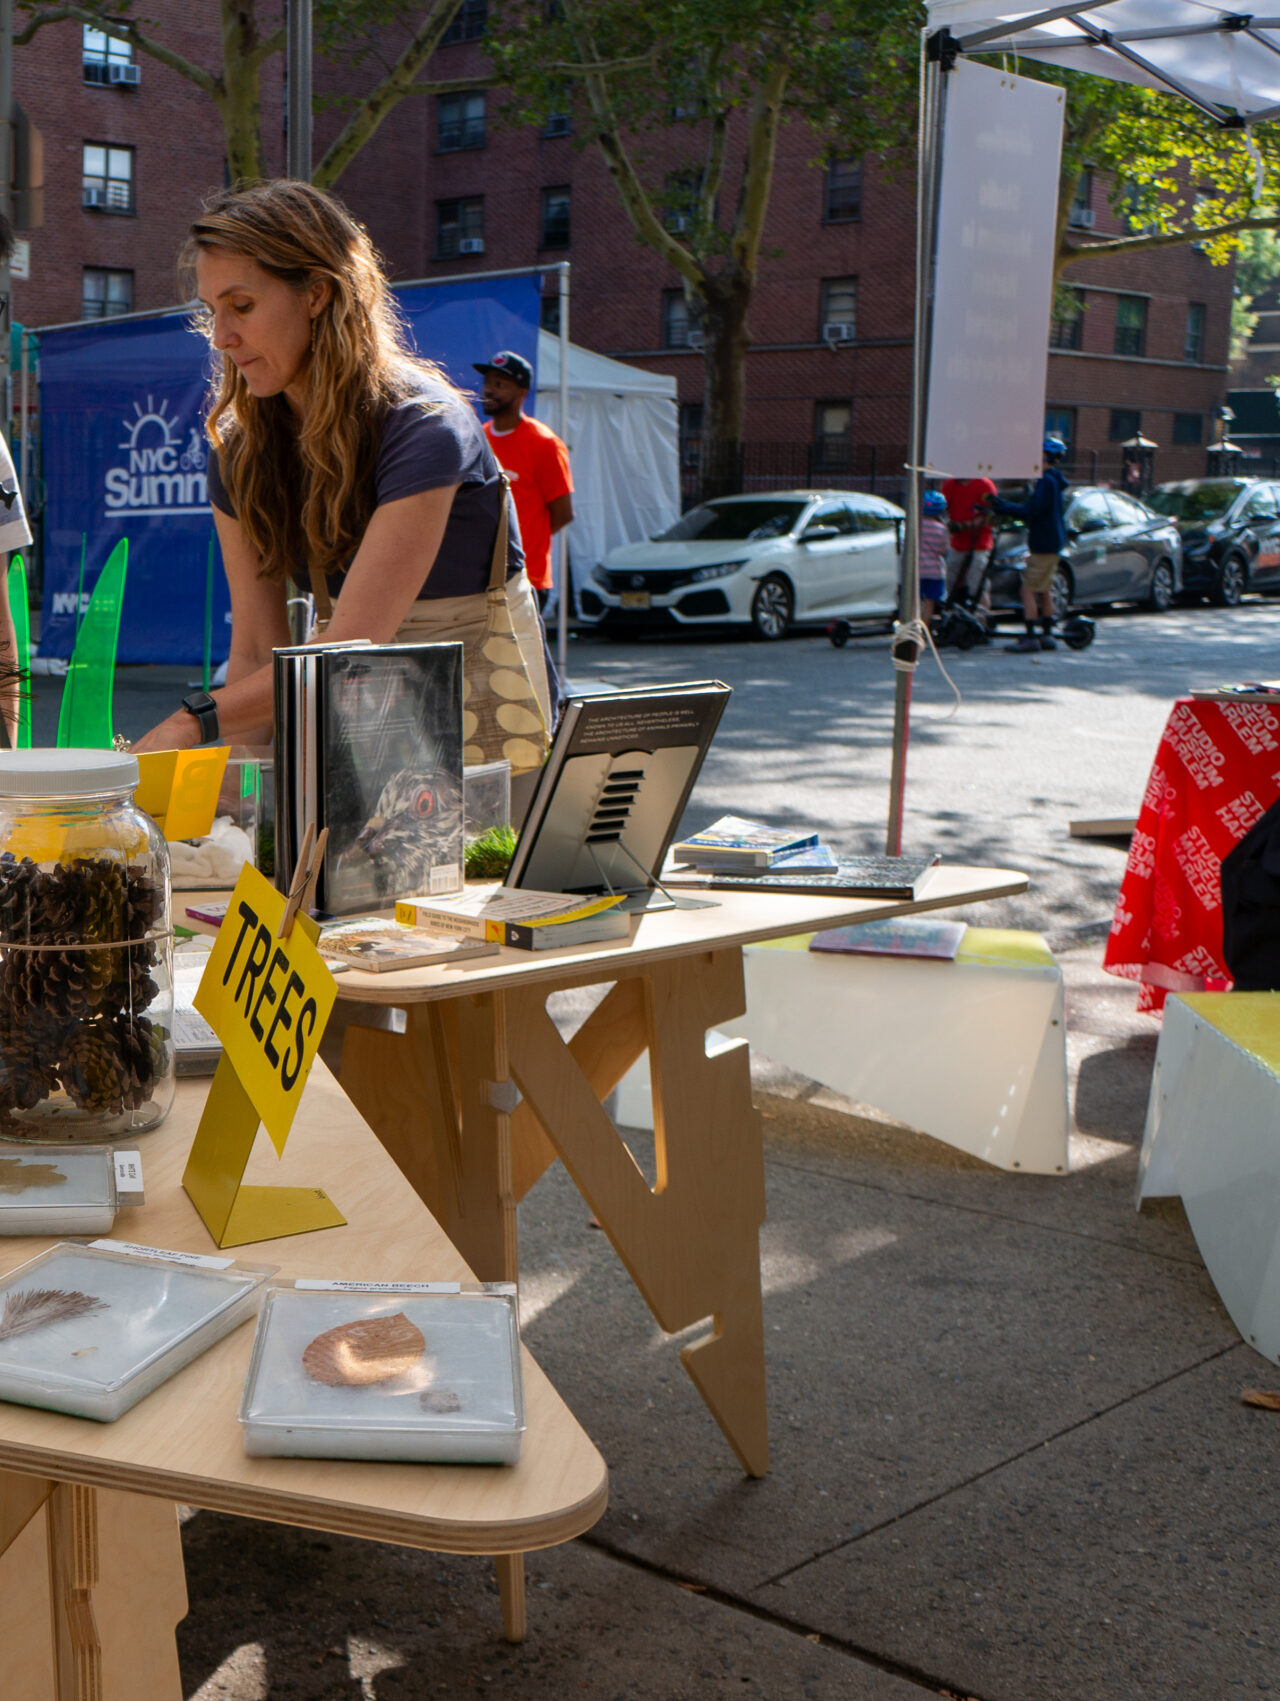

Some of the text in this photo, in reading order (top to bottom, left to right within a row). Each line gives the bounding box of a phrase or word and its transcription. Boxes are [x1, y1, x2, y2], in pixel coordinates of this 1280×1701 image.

[129, 446, 177, 474] NYC
[1168, 712, 1224, 787] MUSEUM
[1176, 704, 1225, 766] STUDIO
[1232, 701, 1279, 752] SEUM
[1163, 728, 1209, 790] HARLEM
[222, 900, 317, 1092] TREES
[123, 1244, 179, 1256] SHORTLEAF
